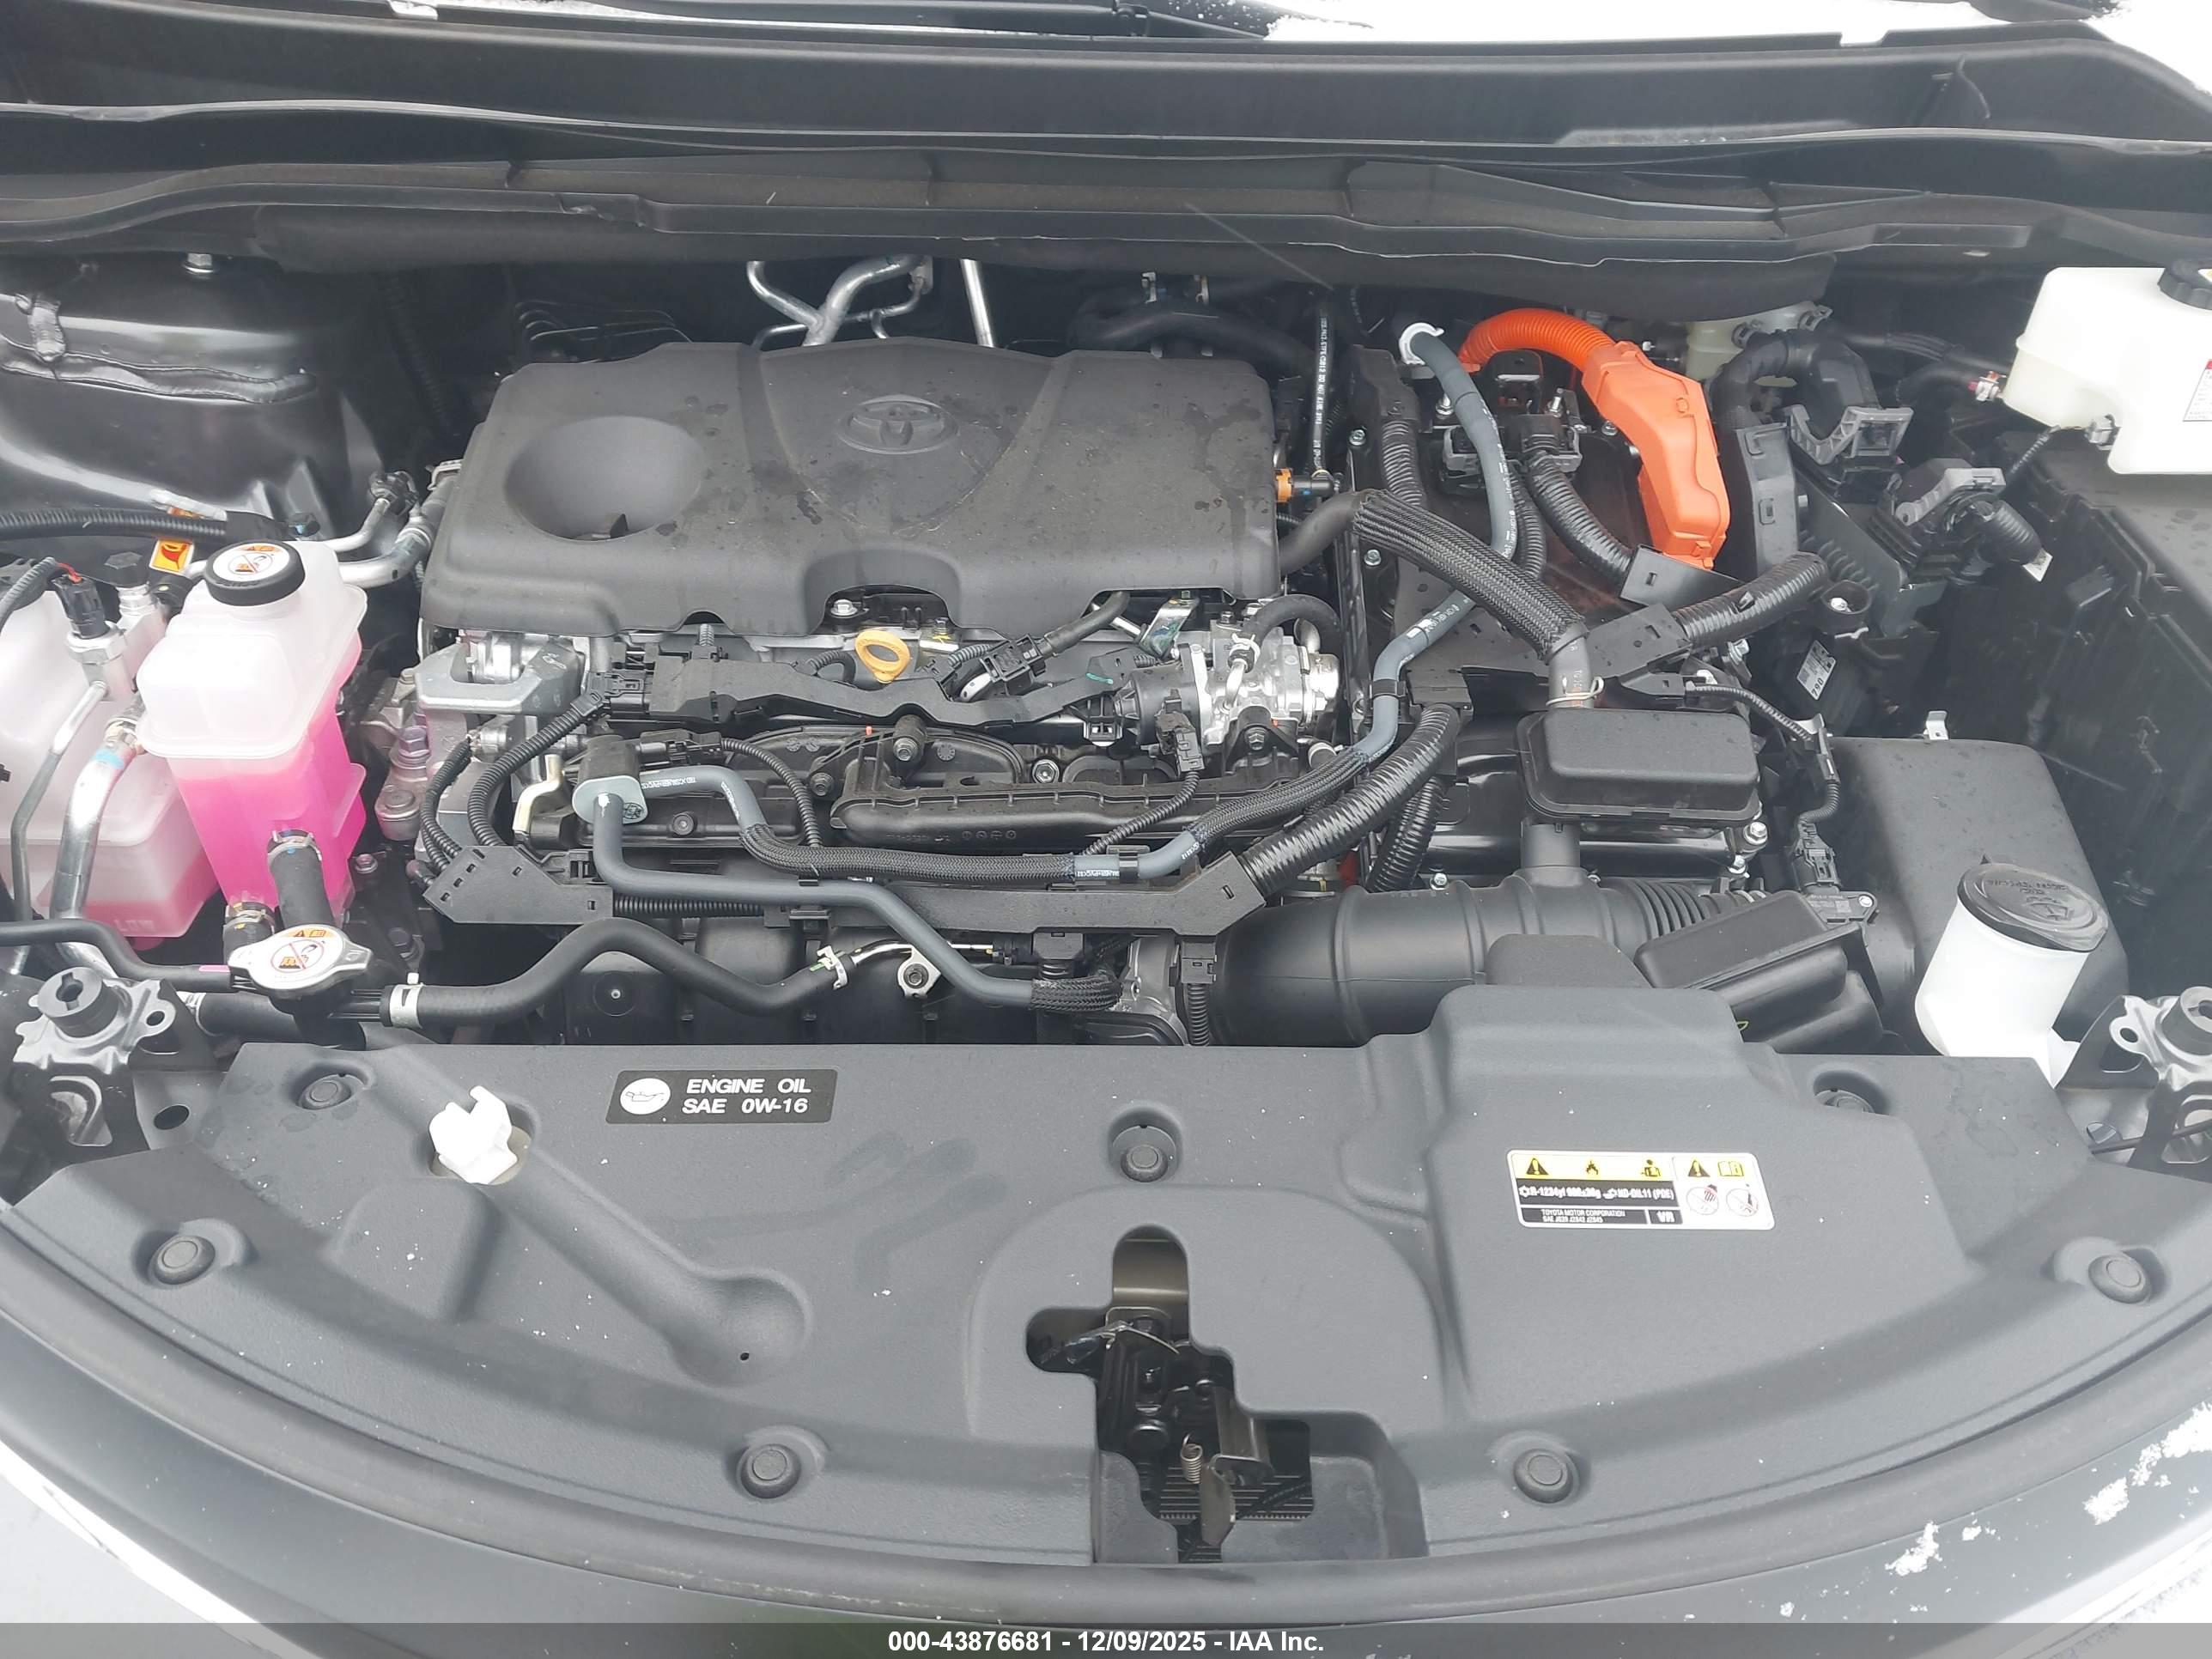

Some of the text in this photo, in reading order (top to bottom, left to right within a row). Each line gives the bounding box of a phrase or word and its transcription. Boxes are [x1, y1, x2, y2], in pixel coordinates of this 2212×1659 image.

[687, 1079, 811, 1093] ENGINE OIL
[683, 1098, 807, 1113] SAE 0W-16
